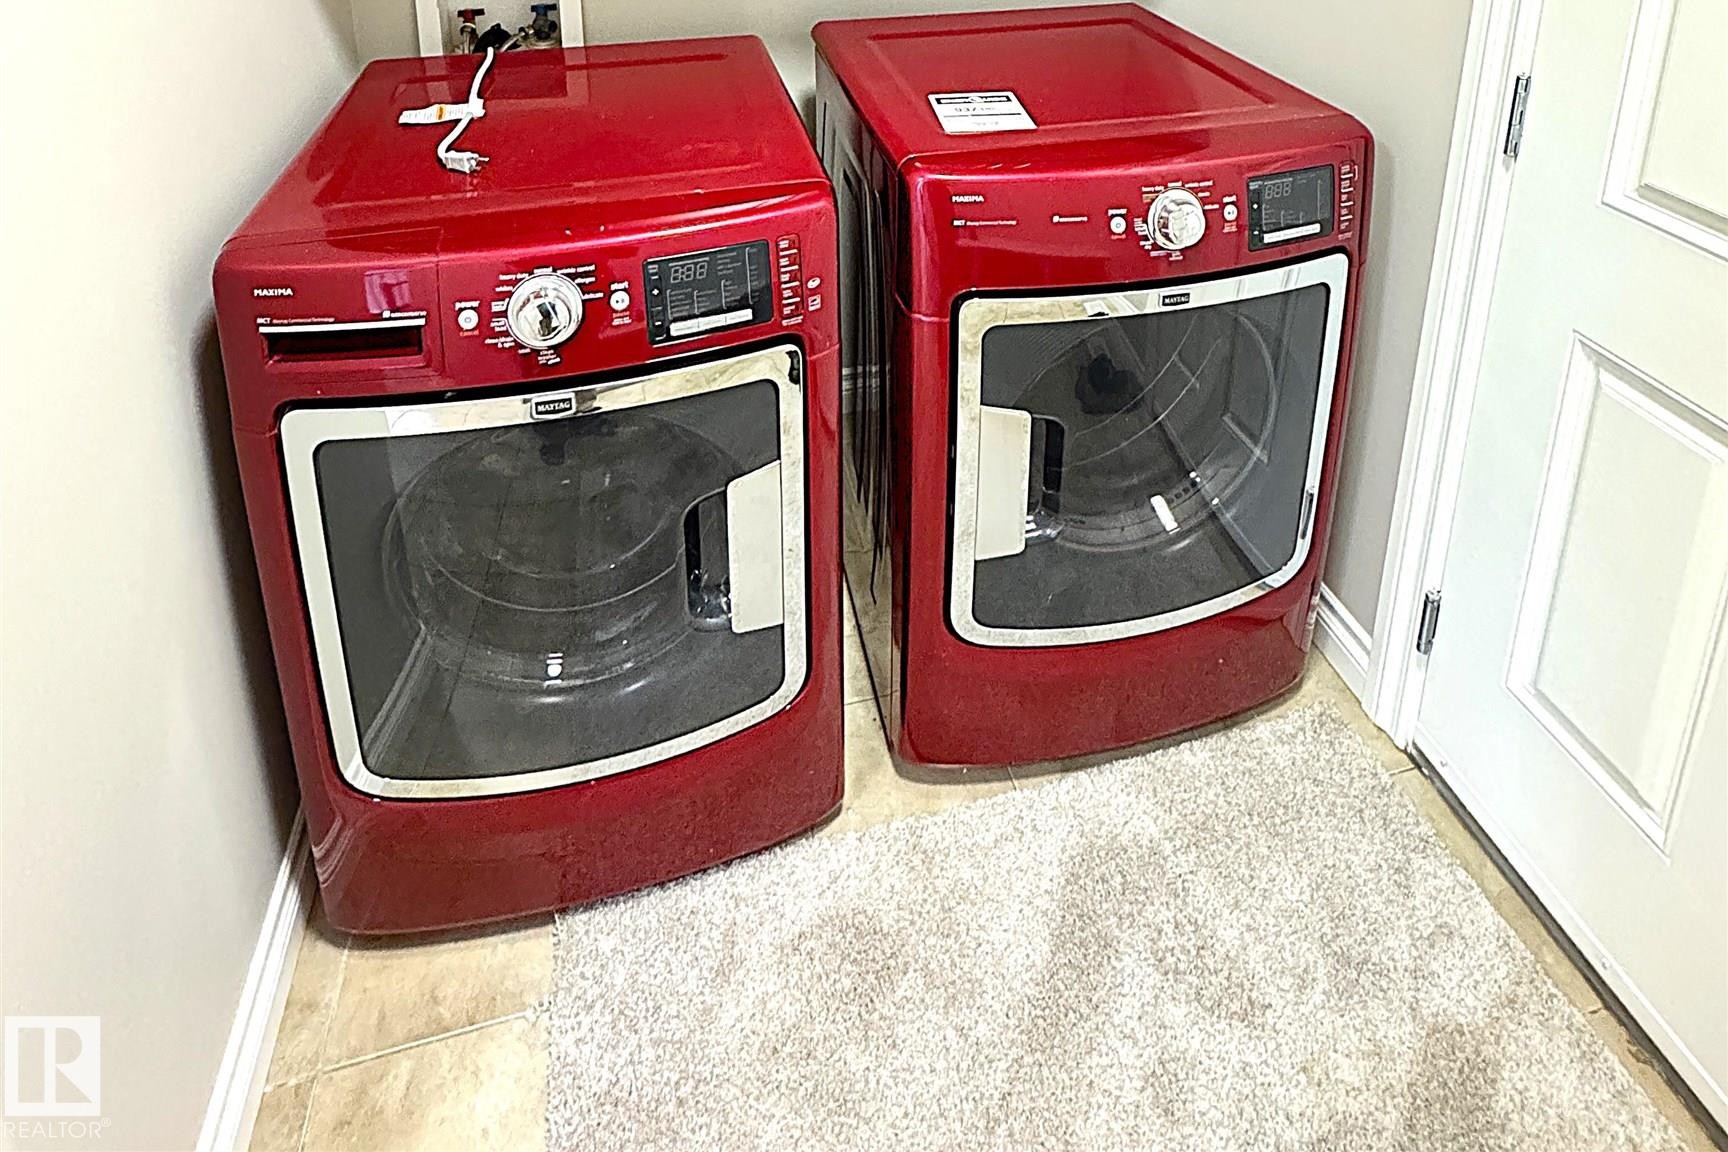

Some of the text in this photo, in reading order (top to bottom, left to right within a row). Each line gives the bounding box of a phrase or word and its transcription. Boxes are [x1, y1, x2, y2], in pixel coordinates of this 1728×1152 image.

[951, 195, 985, 203] MAXIMA
[254, 287, 294, 297] MAXIMA
[1163, 295, 1189, 304] MAYTAG
[537, 400, 571, 412] MAYTAG
